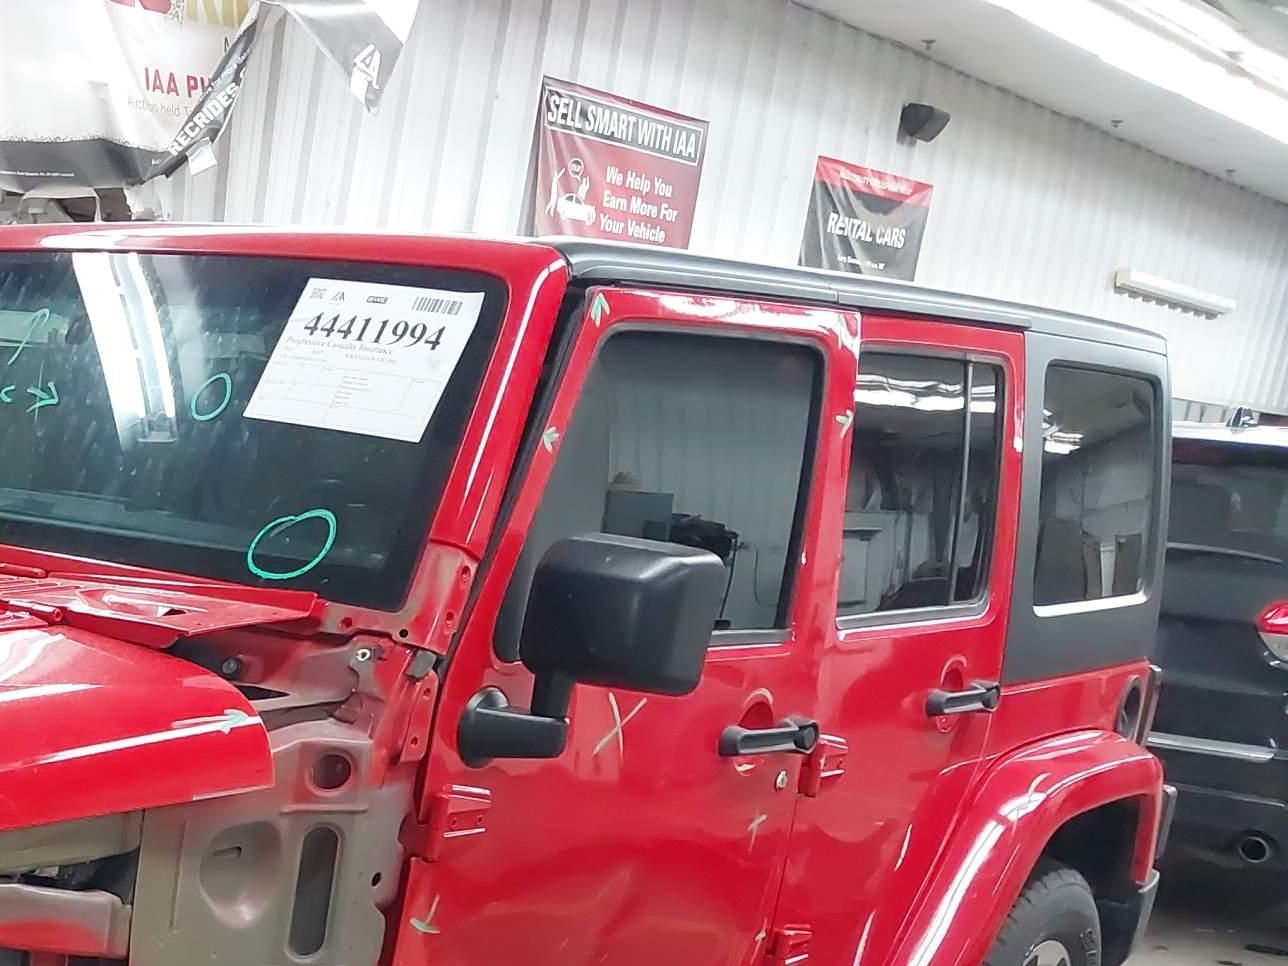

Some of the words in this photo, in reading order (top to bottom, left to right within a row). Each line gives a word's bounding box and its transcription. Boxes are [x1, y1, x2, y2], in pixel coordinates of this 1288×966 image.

[144, 66, 180, 97] IAA
[547, 94, 583, 129] SELL
[585, 104, 637, 142] SMART
[637, 118, 672, 152] WITH
[672, 129, 697, 159] IAA
[606, 165, 623, 186] We
[626, 169, 651, 194] Help
[654, 176, 673, 198] You
[603, 190, 628, 212] Earn
[630, 195, 658, 219] More
[660, 202, 679, 223] For
[599, 213, 625, 235] Your
[627, 218, 666, 244] Vehicle
[827, 212, 873, 243] RENTAL
[876, 225, 906, 249] CARS
[304, 311, 447, 351] 44411994
